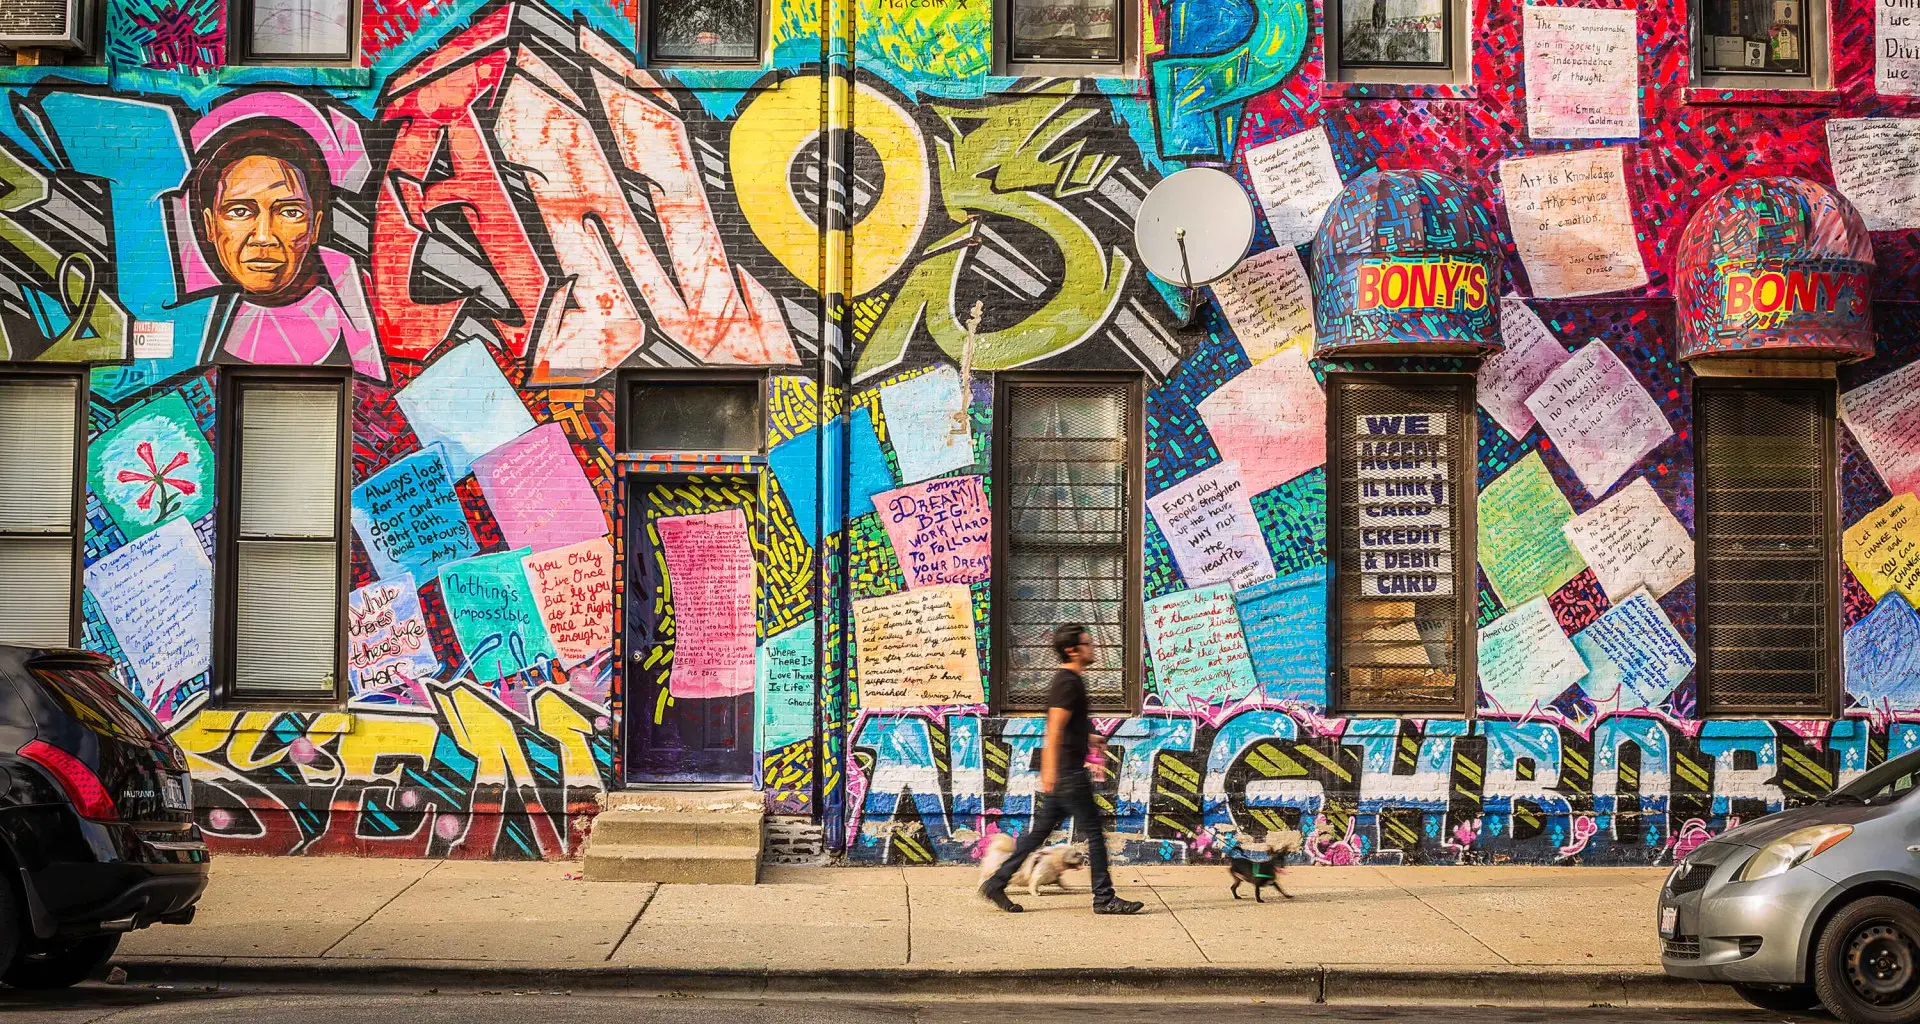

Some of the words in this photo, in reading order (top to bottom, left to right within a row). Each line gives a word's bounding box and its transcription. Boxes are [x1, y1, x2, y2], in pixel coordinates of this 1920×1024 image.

[1519, 173, 1542, 188] Art
[1548, 174, 1558, 185] is
[1543, 195, 1566, 209] the
[1539, 219, 1550, 231] of
[1358, 264, 1487, 310] BONY'S
[1538, 395, 1555, 409] La
[1555, 360, 1595, 393] libertad
[1550, 407, 1562, 422] no
[1366, 416, 1429, 435] WE
[365, 472, 413, 502] Always
[411, 458, 444, 480] look
[371, 499, 392, 515] for
[395, 487, 418, 504] the
[419, 473, 446, 494] right
[1162, 491, 1194, 513] Every
[1196, 478, 1218, 496] day
[370, 509, 405, 536] door
[434, 489, 458, 504] the
[1168, 503, 1197, 527] people
[1366, 501, 1432, 517] CARD
[1188, 528, 1212, 548] WHY
[1215, 513, 1236, 531] not
[1189, 514, 1206, 526] the
[372, 527, 410, 552] right
[1362, 525, 1442, 546] CREDIT
[1856, 530, 1871, 546] Let
[1875, 517, 1887, 529] the
[1203, 540, 1226, 555] the
[1864, 532, 1892, 559] CHANGE
[1887, 536, 1902, 552] and
[1384, 548, 1441, 569] DEBIT
[1879, 558, 1898, 577] YOU
[588, 580, 610, 600] you
[1377, 571, 1437, 594] CARD
[768, 683, 780, 691] Is
